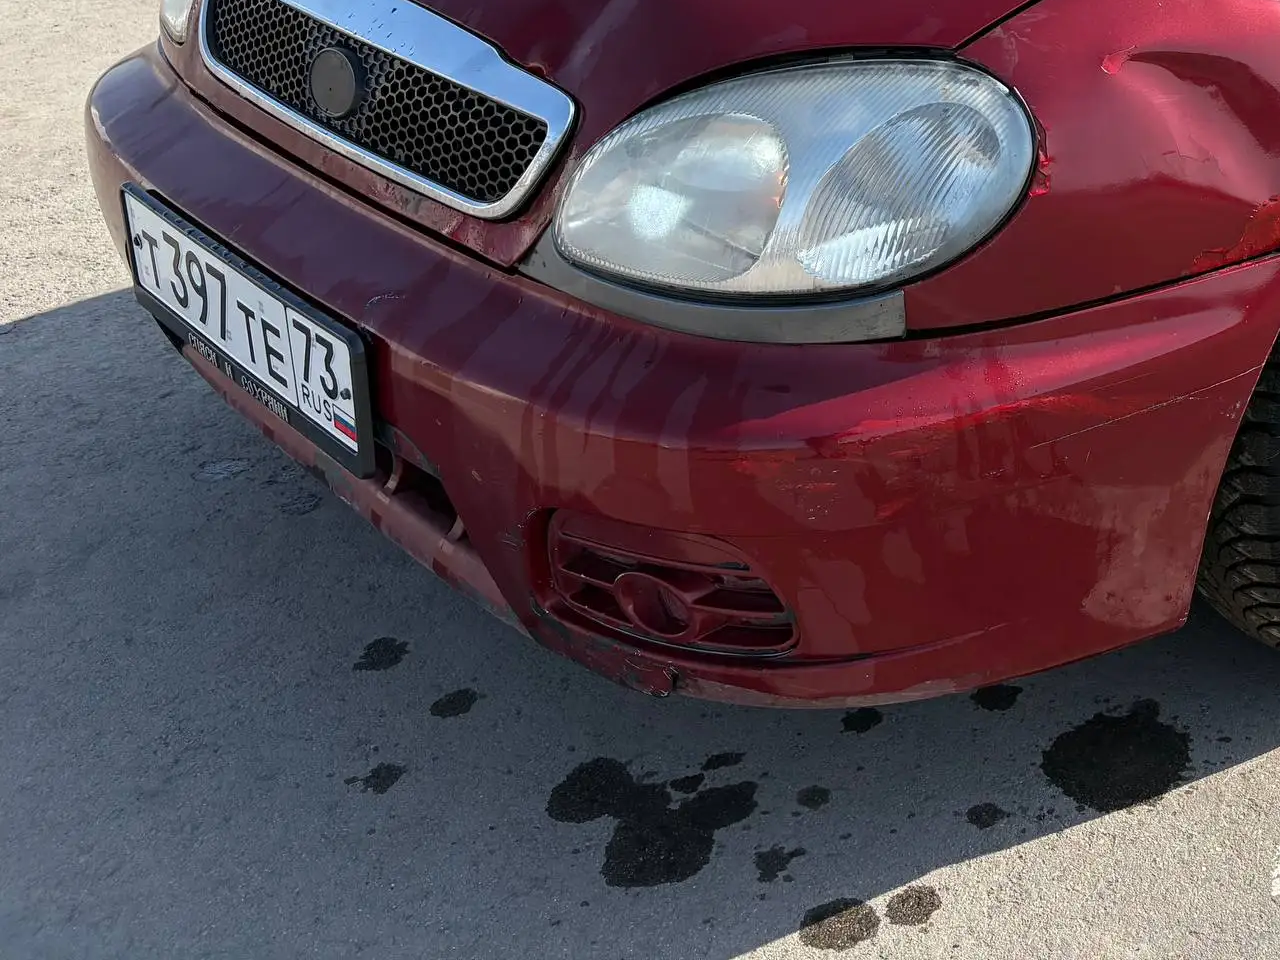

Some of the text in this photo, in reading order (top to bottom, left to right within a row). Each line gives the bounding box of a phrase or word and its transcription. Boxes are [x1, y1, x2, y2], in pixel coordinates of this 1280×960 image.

[224, 361, 233, 381] И
[292, 318, 338, 400] 73
[301, 383, 333, 422] RUS
